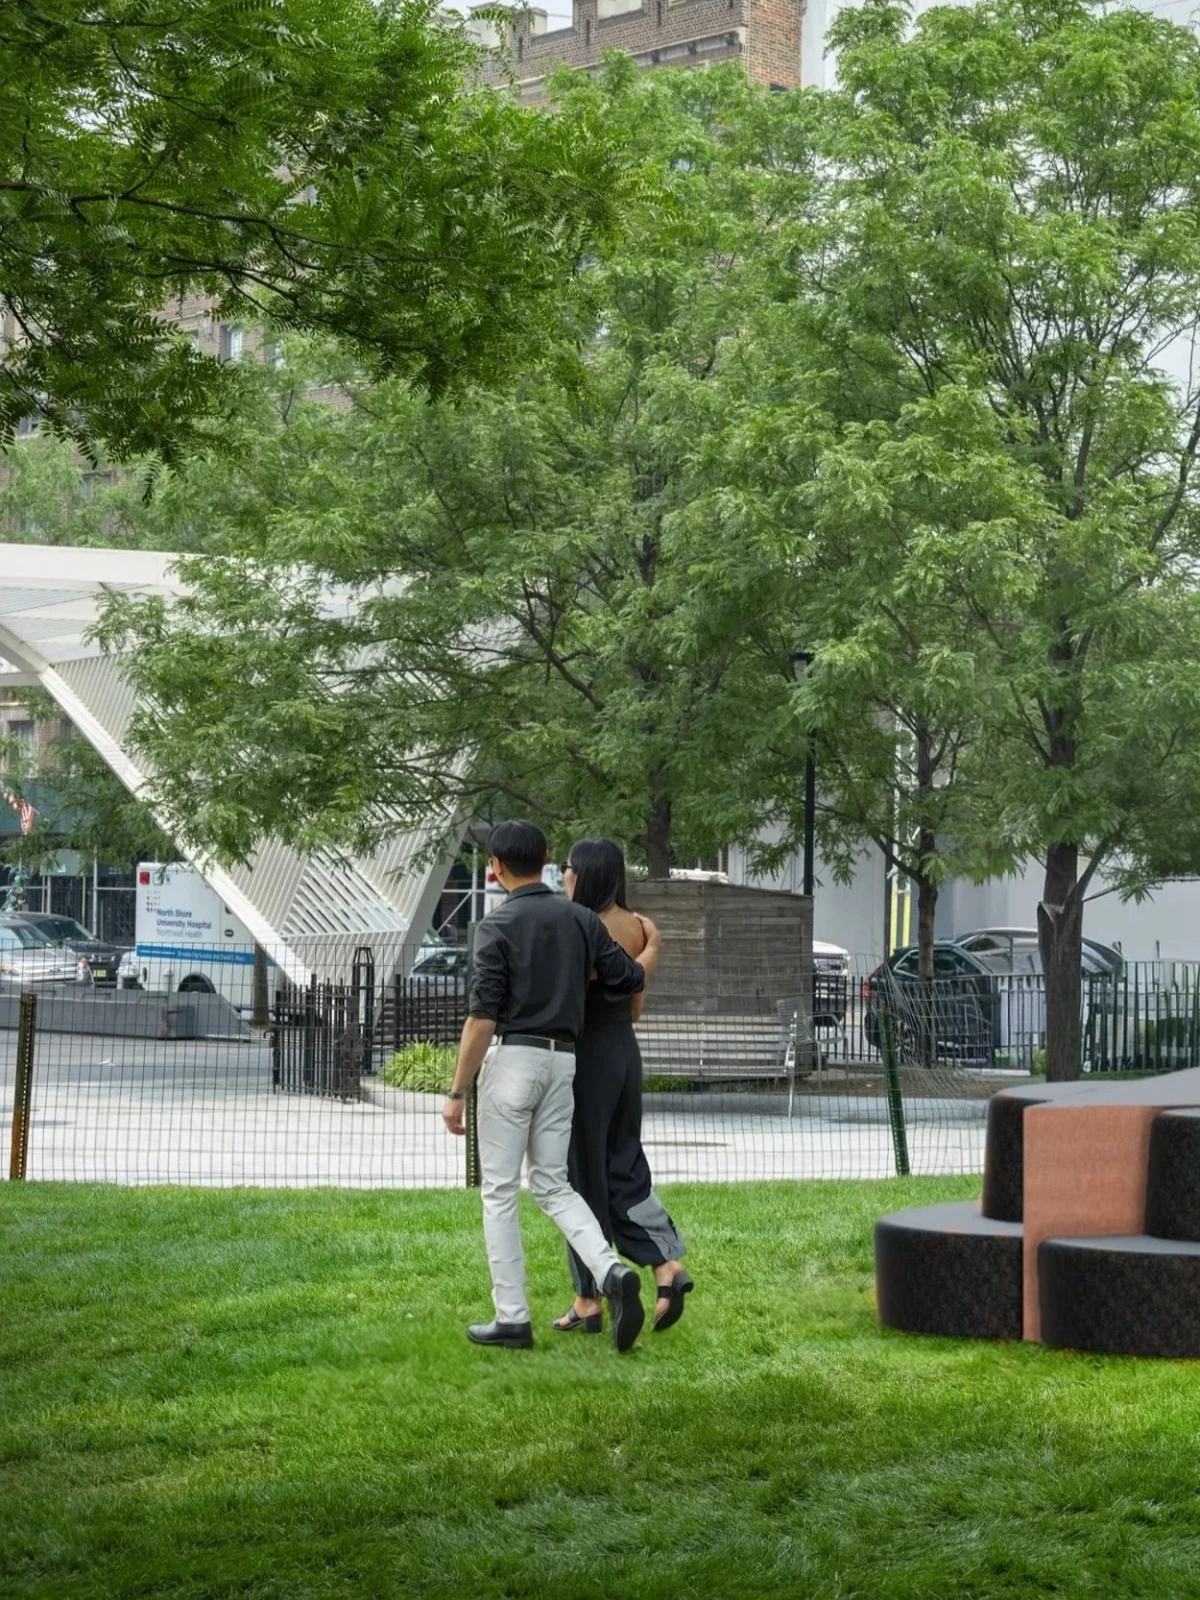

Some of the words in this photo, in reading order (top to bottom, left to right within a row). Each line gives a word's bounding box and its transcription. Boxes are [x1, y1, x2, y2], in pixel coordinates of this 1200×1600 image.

[156, 909, 173, 917] North
[175, 909, 192, 918] Shore
[156, 918, 185, 928] University
[187, 920, 211, 930] Hospital
